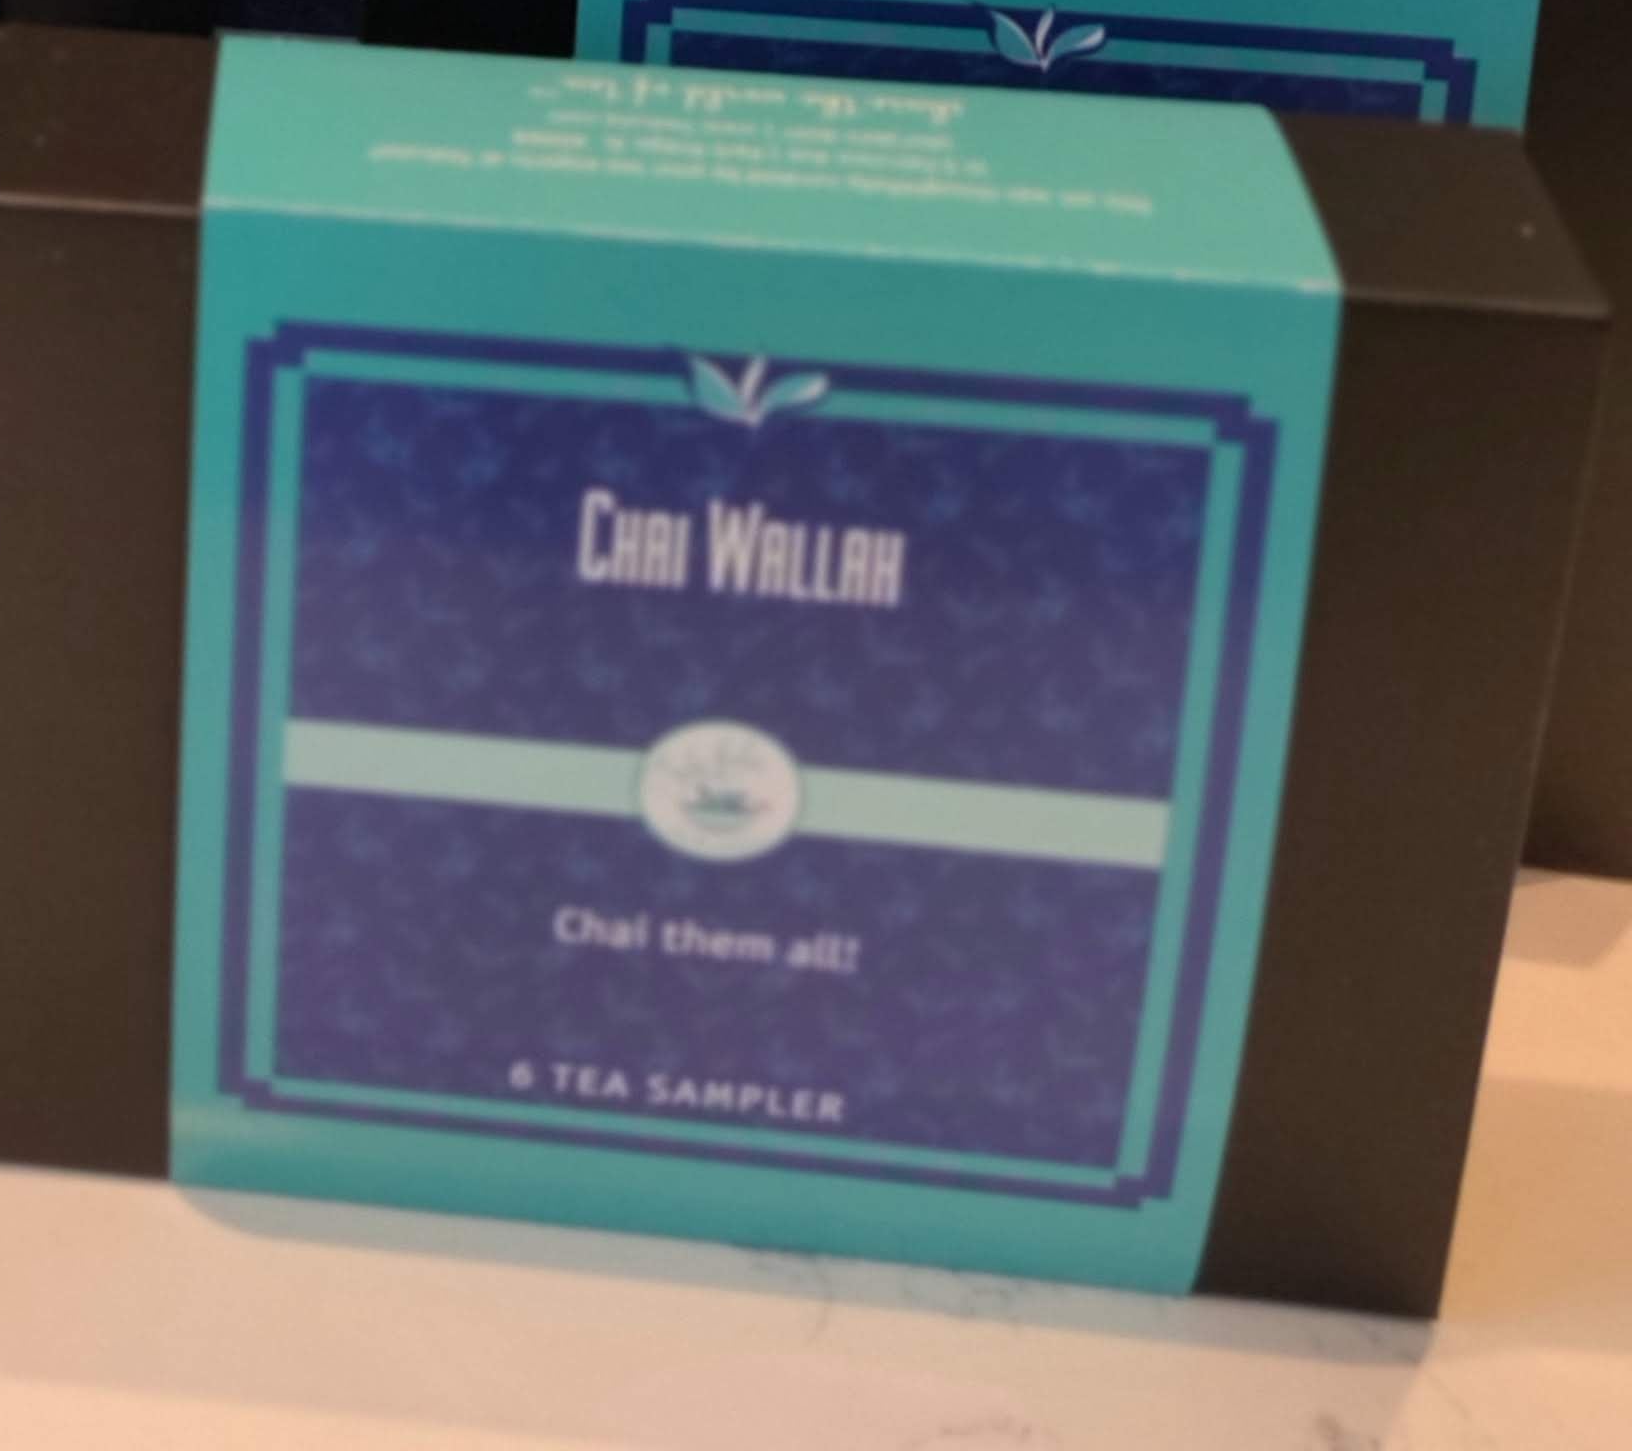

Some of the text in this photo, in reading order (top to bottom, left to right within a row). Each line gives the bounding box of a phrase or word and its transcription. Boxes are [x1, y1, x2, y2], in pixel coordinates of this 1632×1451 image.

[577, 487, 907, 607] CHAI WALLAH
[553, 907, 861, 976] Chai them all!
[510, 1061, 847, 1123] 6 TEA SAMPLER
